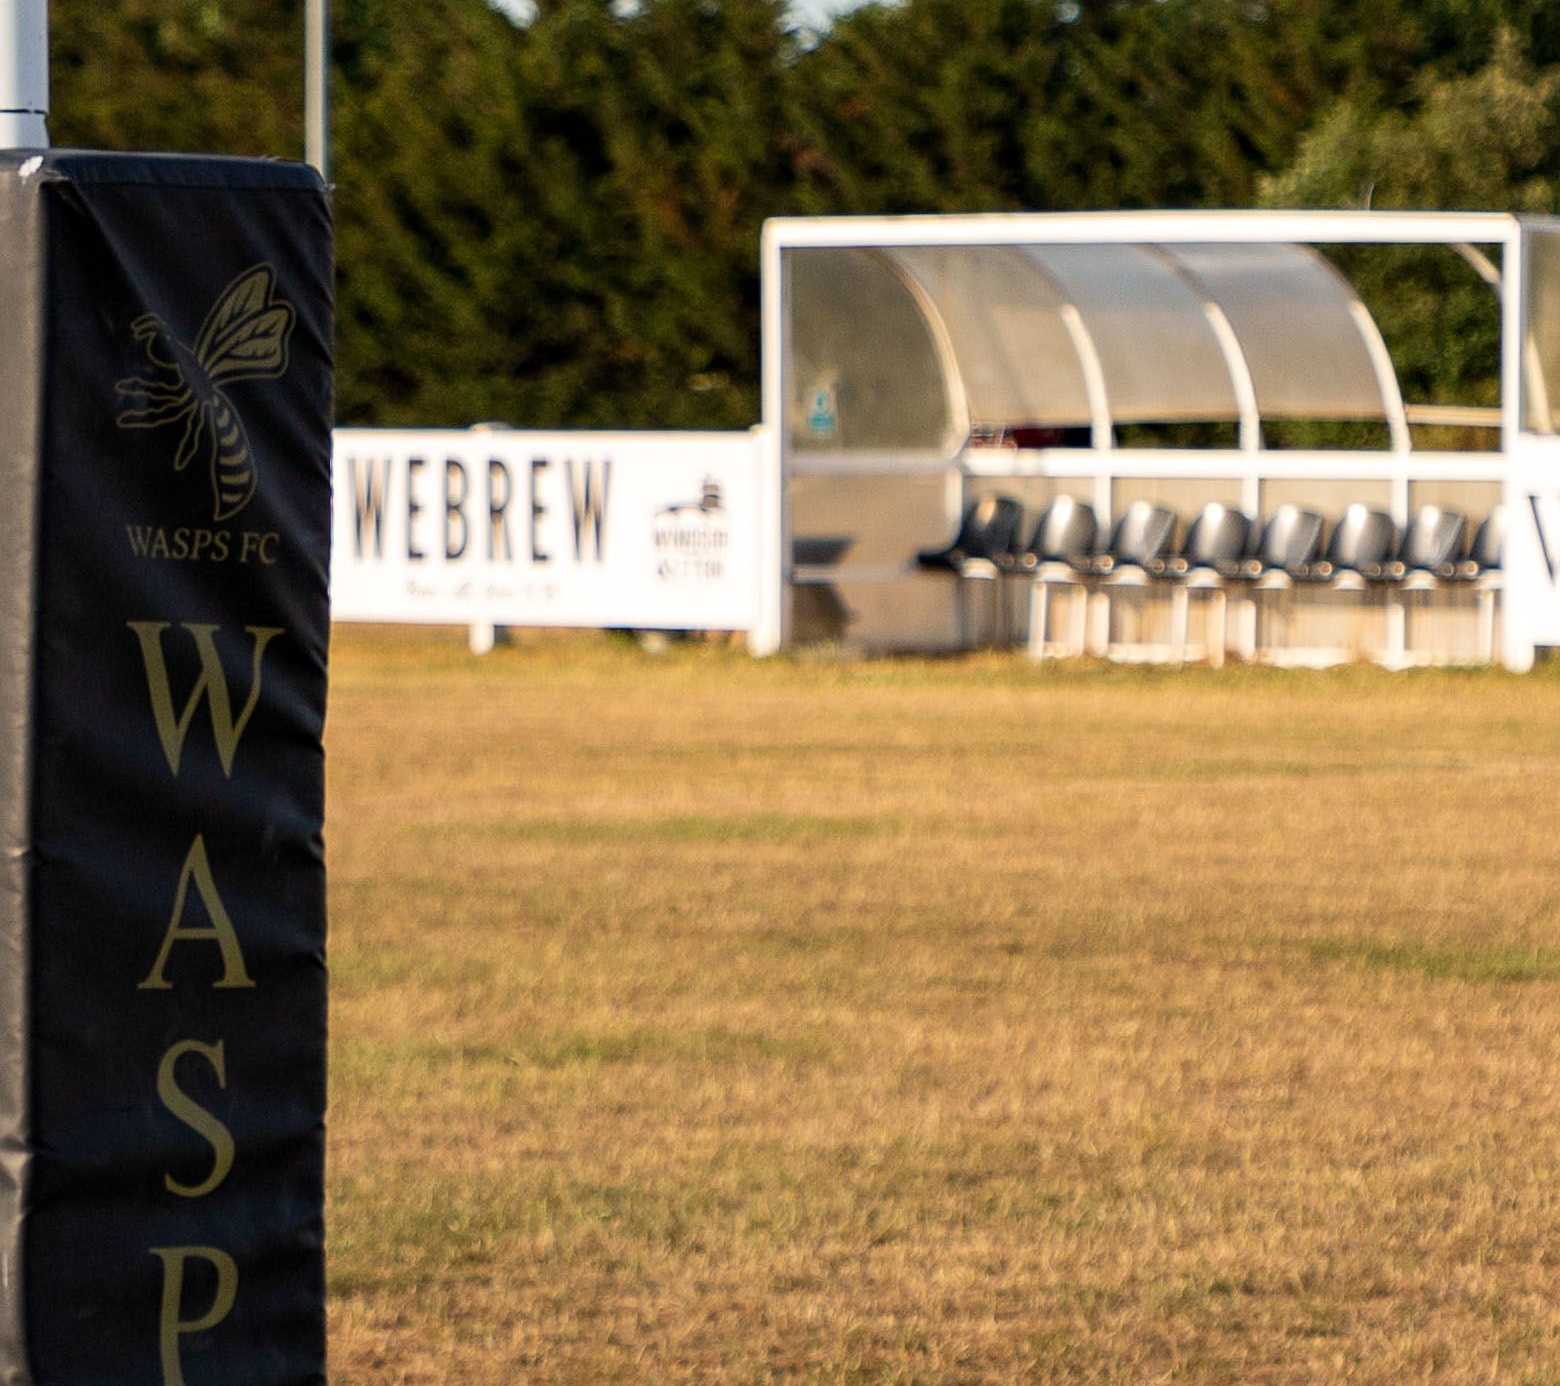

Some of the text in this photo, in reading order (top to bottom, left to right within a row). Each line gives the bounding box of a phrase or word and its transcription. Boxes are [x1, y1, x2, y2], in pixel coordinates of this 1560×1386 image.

[126, 524, 280, 566] WASPS FC
[347, 456, 613, 562] WEBREW
